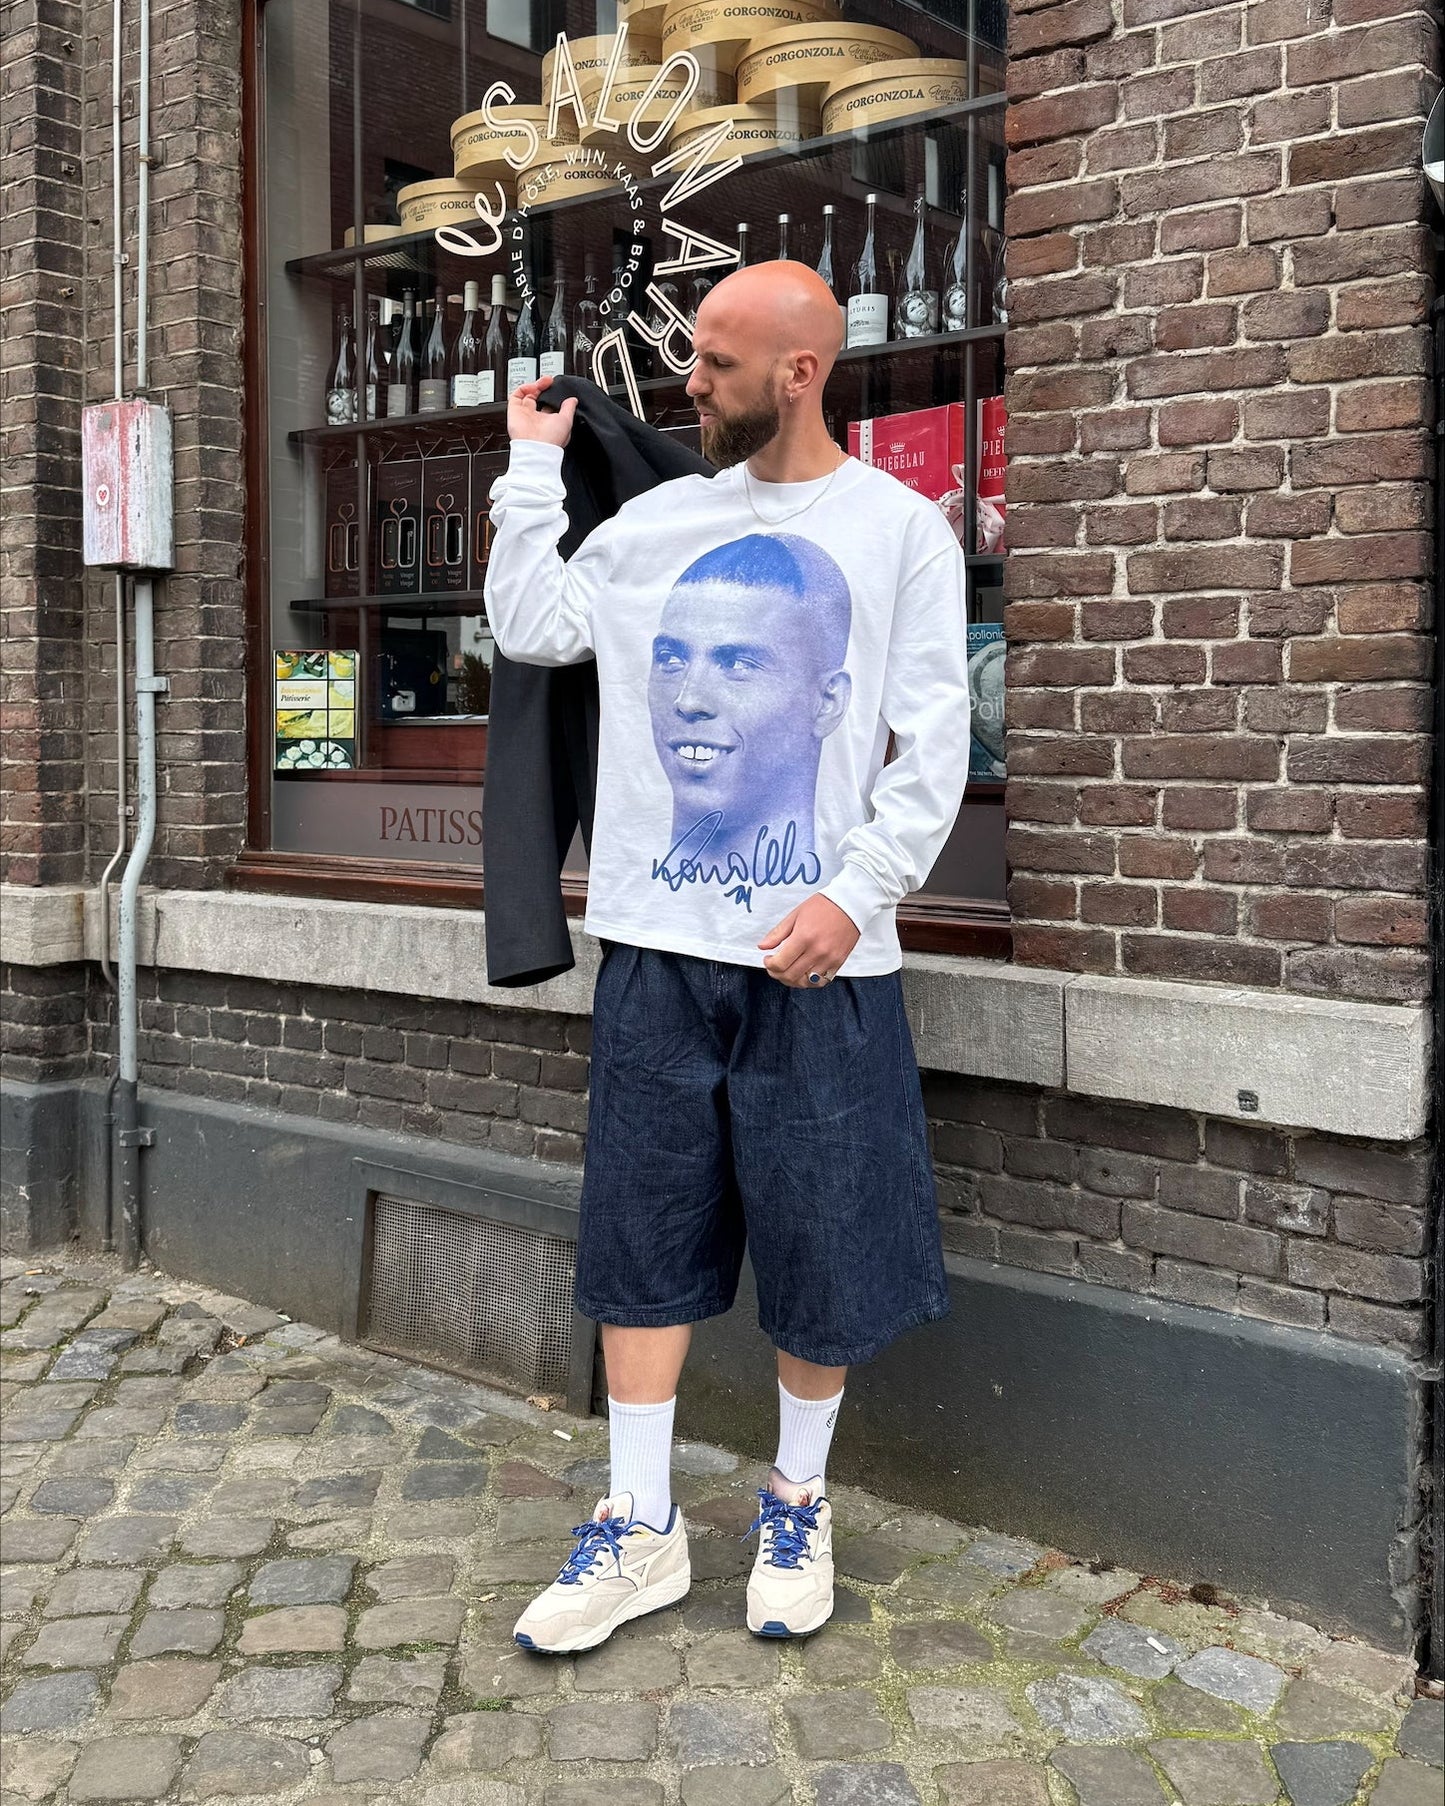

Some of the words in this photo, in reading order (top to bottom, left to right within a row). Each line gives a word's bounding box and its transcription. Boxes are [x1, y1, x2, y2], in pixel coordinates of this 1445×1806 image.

[724, 7, 803, 21] GORGONZOLA
[766, 47, 845, 66] GORGONZOLA
[615, 90, 692, 103] GORGNZO
[846, 88, 925, 112] GORGONZOLA
[726, 129, 804, 142] GORGONZOLA
[564, 149, 608, 171] WIJN,
[564, 170, 637, 182] GORGONZ
[613, 162, 643, 210] KAAS
[434, 181, 507, 256] le
[633, 219, 646, 235] &
[511, 250, 536, 310] TABLE
[599, 244, 643, 315] BROOD
[967, 629, 1006, 642] polloni
